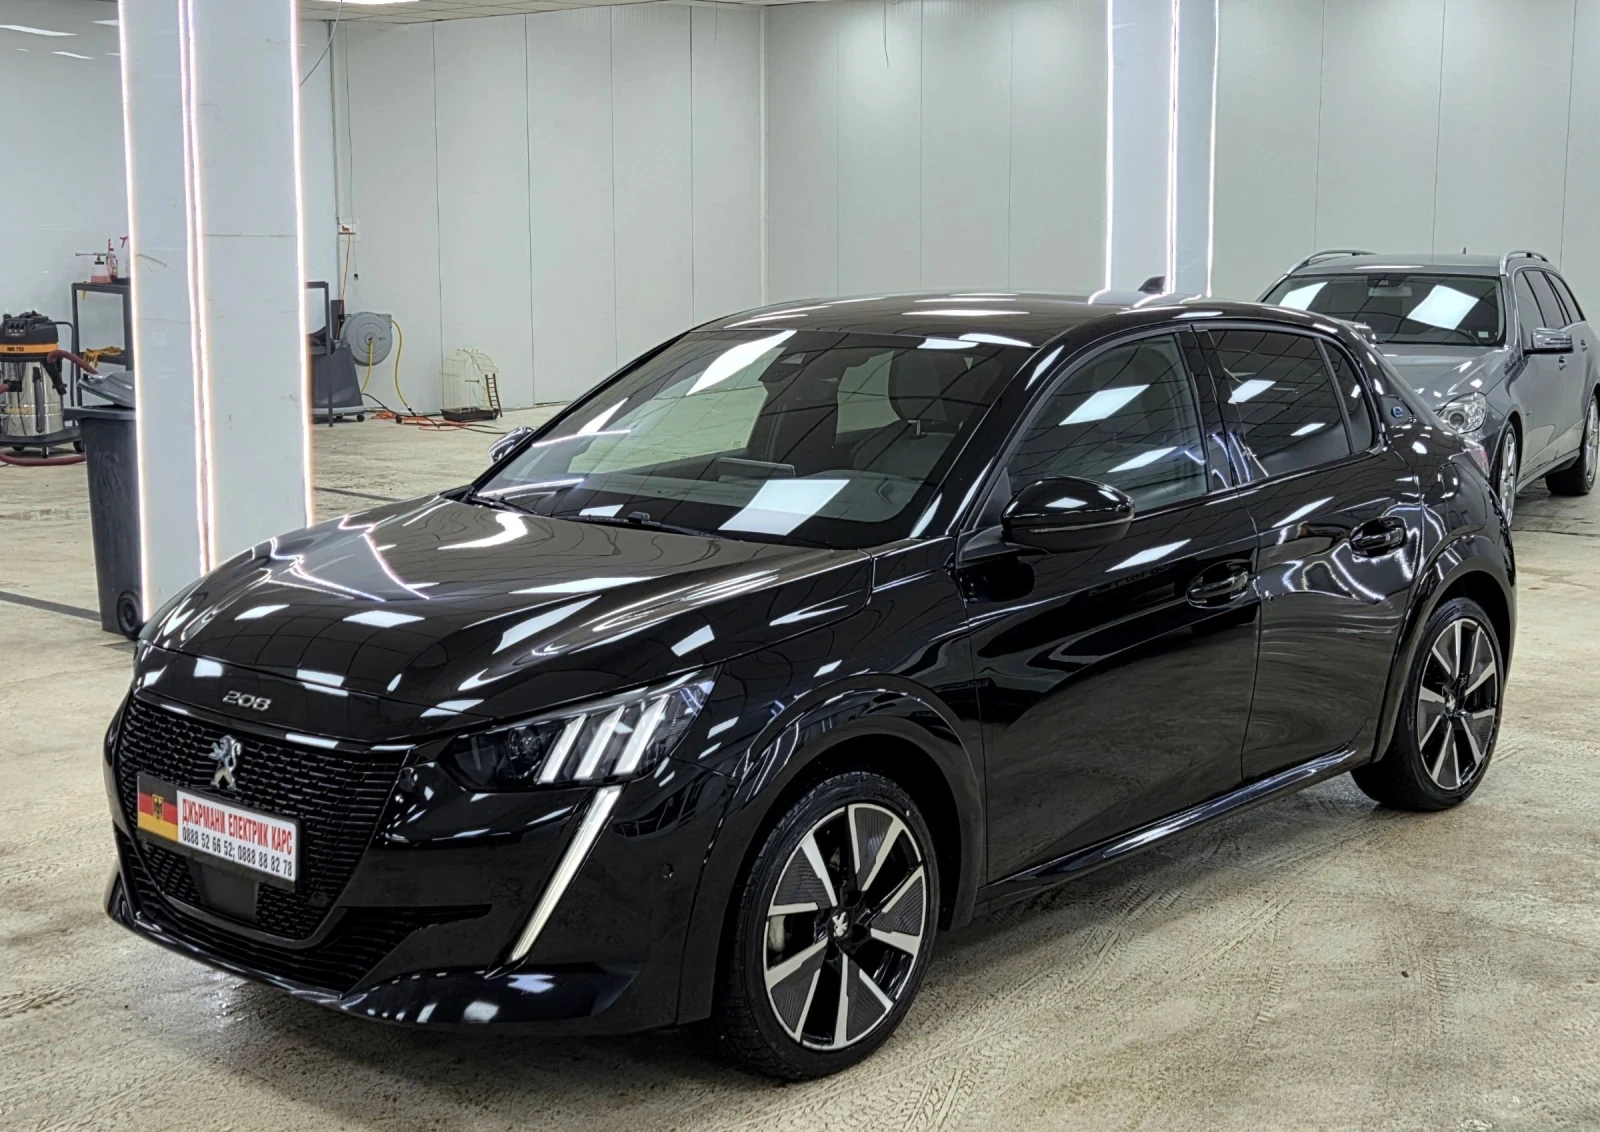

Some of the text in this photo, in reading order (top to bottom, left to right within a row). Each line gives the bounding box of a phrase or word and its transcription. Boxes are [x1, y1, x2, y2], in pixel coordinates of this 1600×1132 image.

[222, 690, 272, 712] 208
[182, 798, 292, 856] ДЖЪРМАНИ ЕЛЕКТРИК КАРС
[182, 826, 199, 846] 0888
[201, 832, 210, 850] 52
[212, 836, 222, 854] 66
[237, 844, 256, 865] 0888
[258, 851, 268, 869] 88
[270, 855, 280, 873] 82
[283, 859, 292, 877] 78
